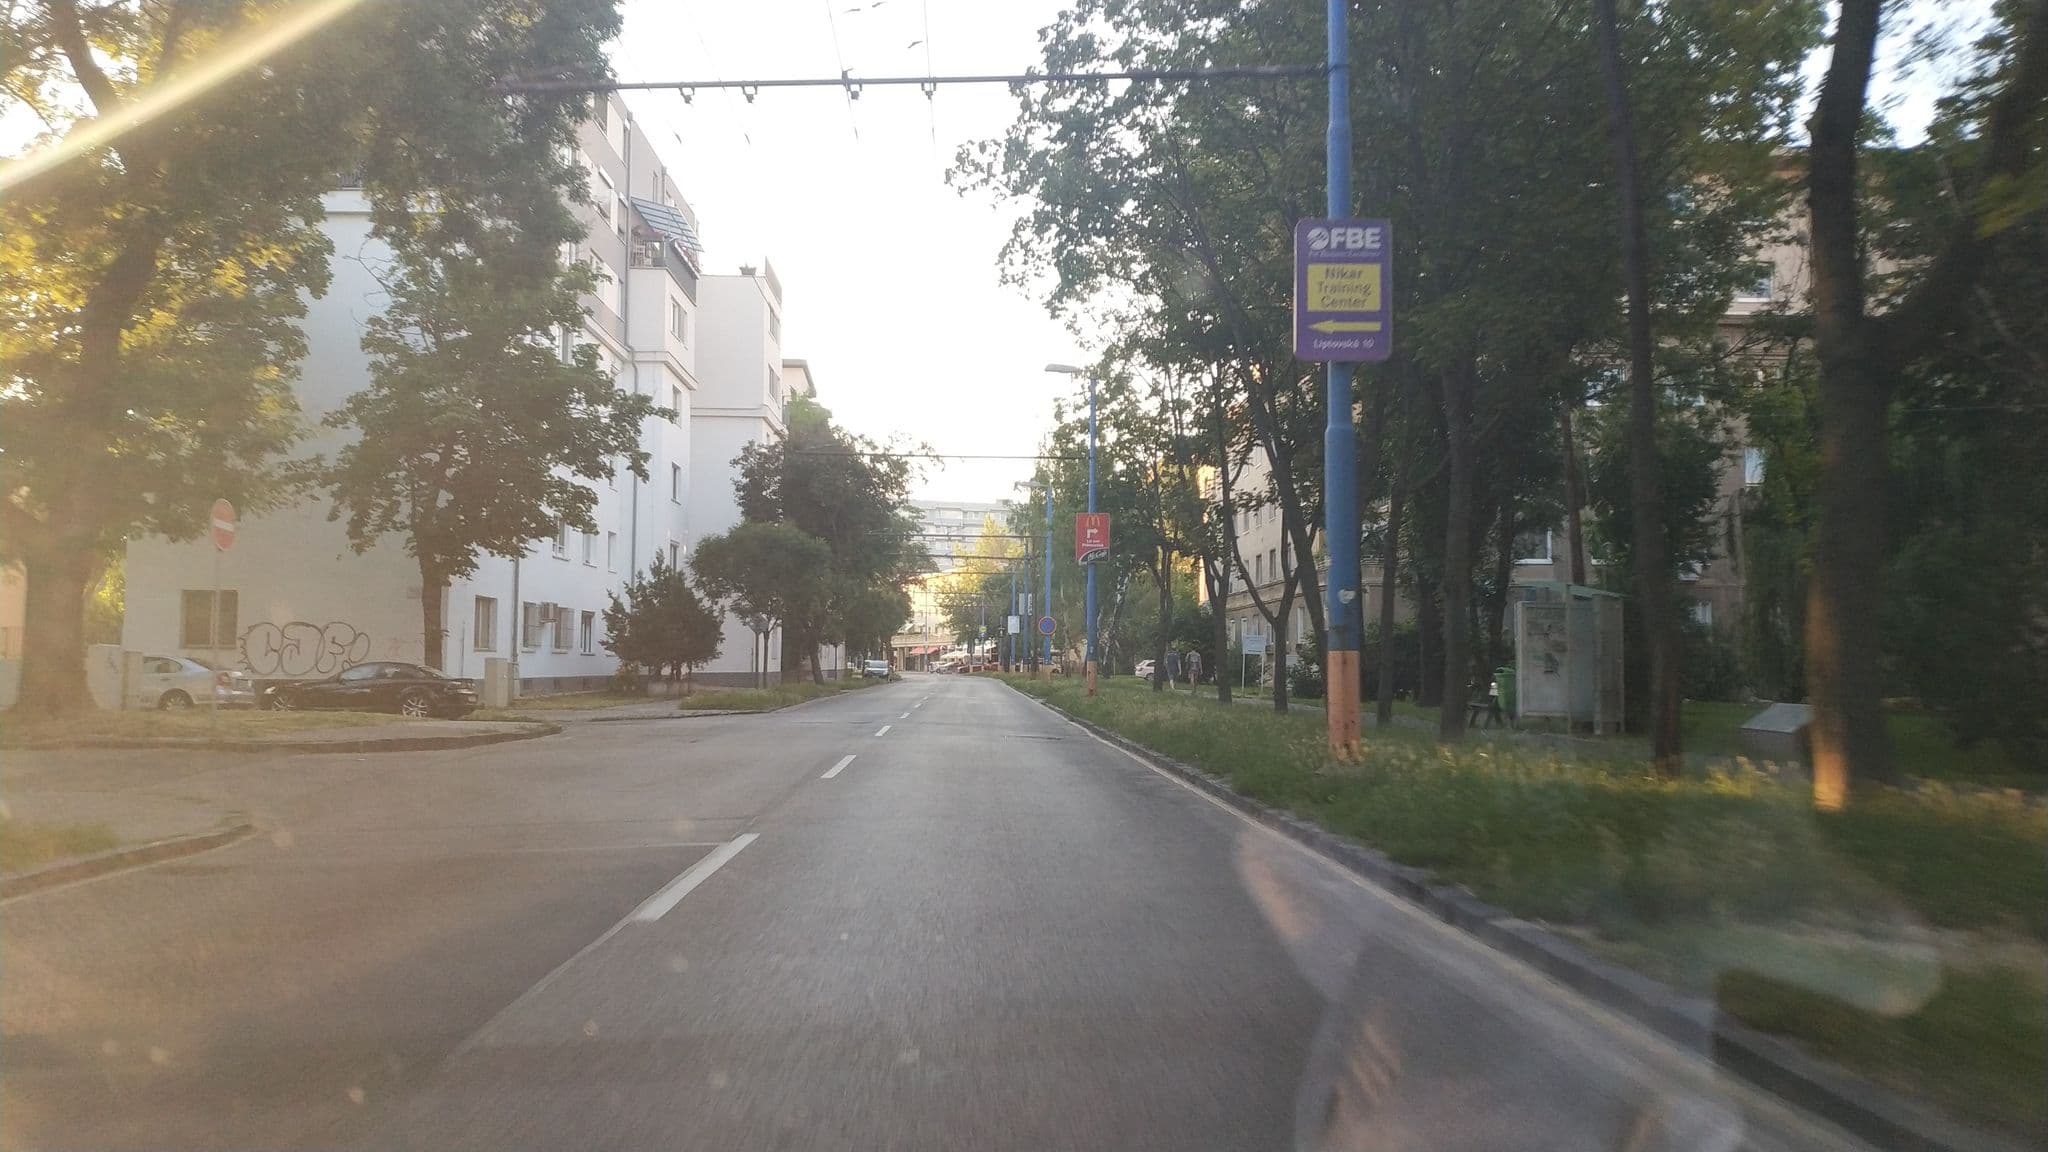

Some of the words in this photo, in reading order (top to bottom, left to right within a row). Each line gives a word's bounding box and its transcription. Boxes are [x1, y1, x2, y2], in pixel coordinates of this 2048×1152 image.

[1331, 227, 1381, 249] FBE
[1317, 281, 1372, 297] Training
[1321, 296, 1367, 309] Center
